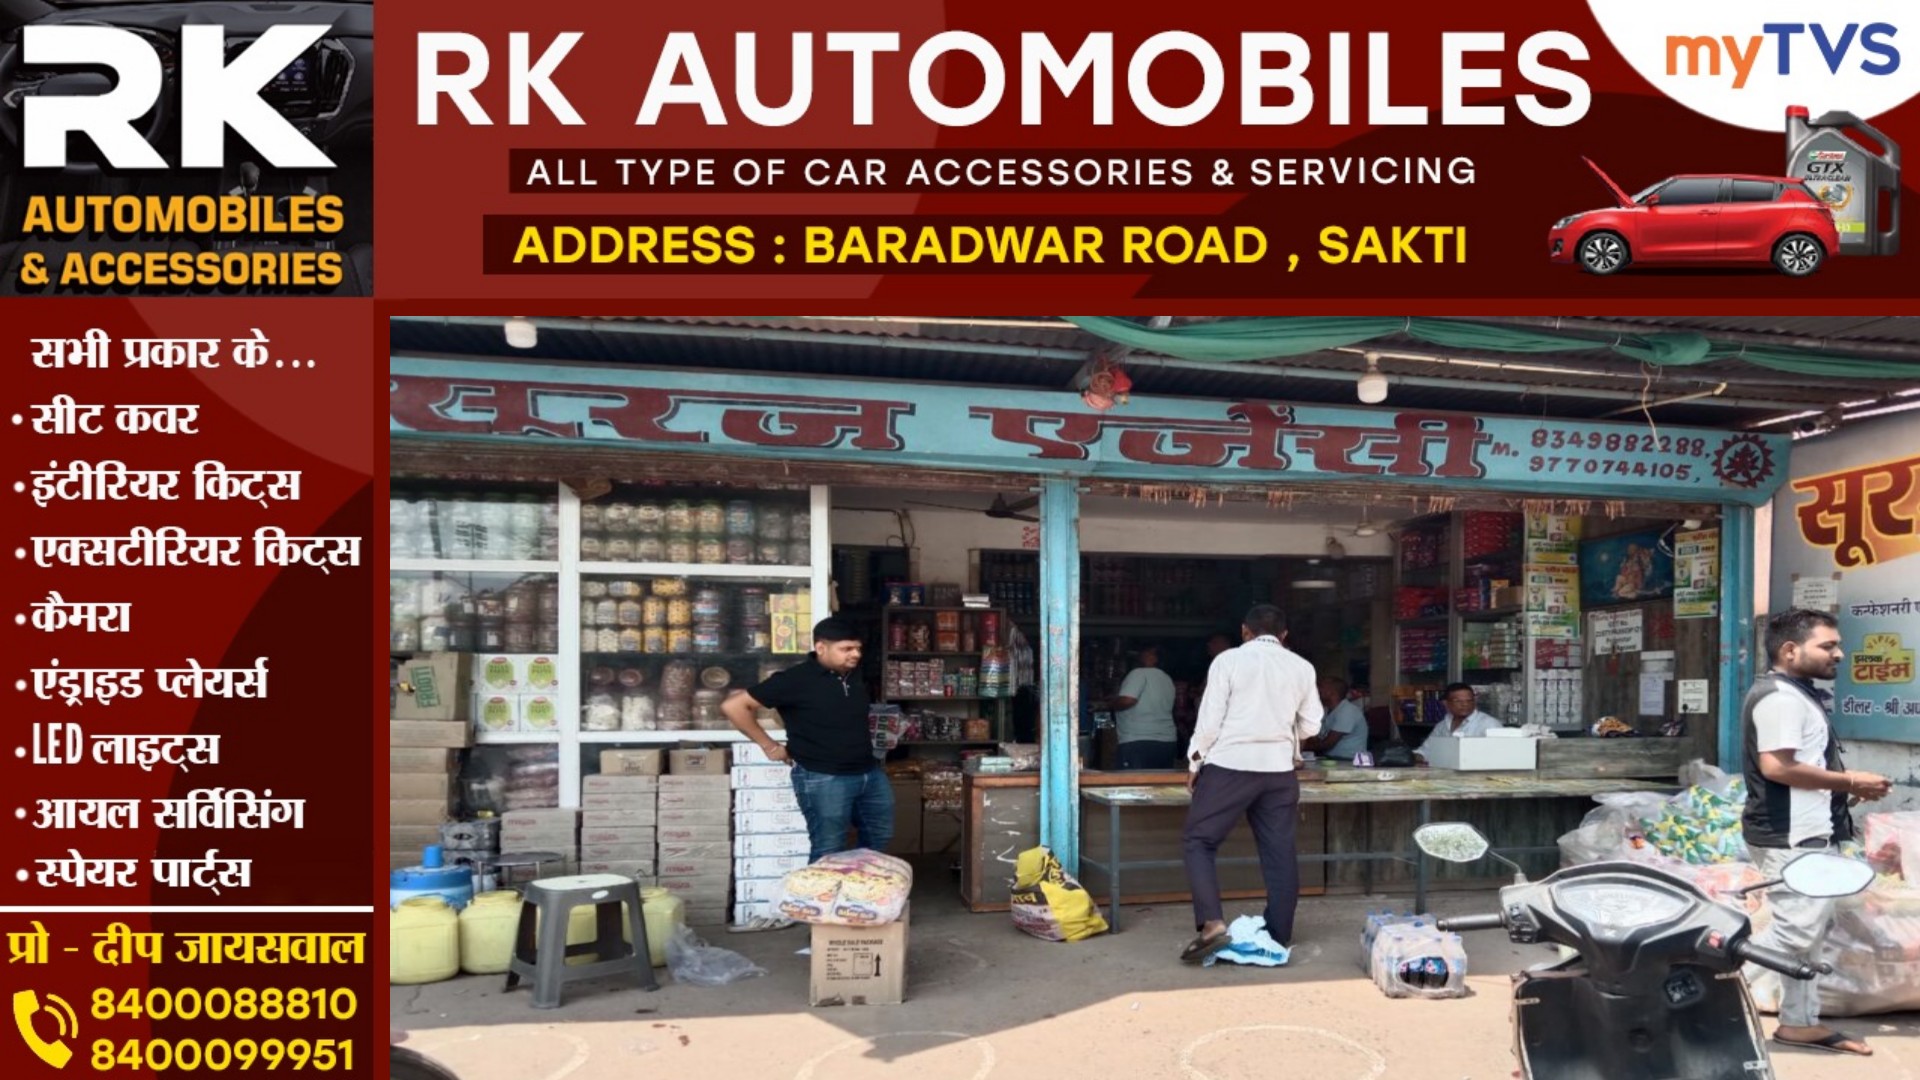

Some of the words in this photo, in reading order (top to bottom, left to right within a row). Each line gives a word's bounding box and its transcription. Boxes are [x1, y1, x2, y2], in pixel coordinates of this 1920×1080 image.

[1806, 161, 1845, 174] GTX
[1791, 457, 1920, 568] सूर
[1885, 697, 1900, 715] श्री
